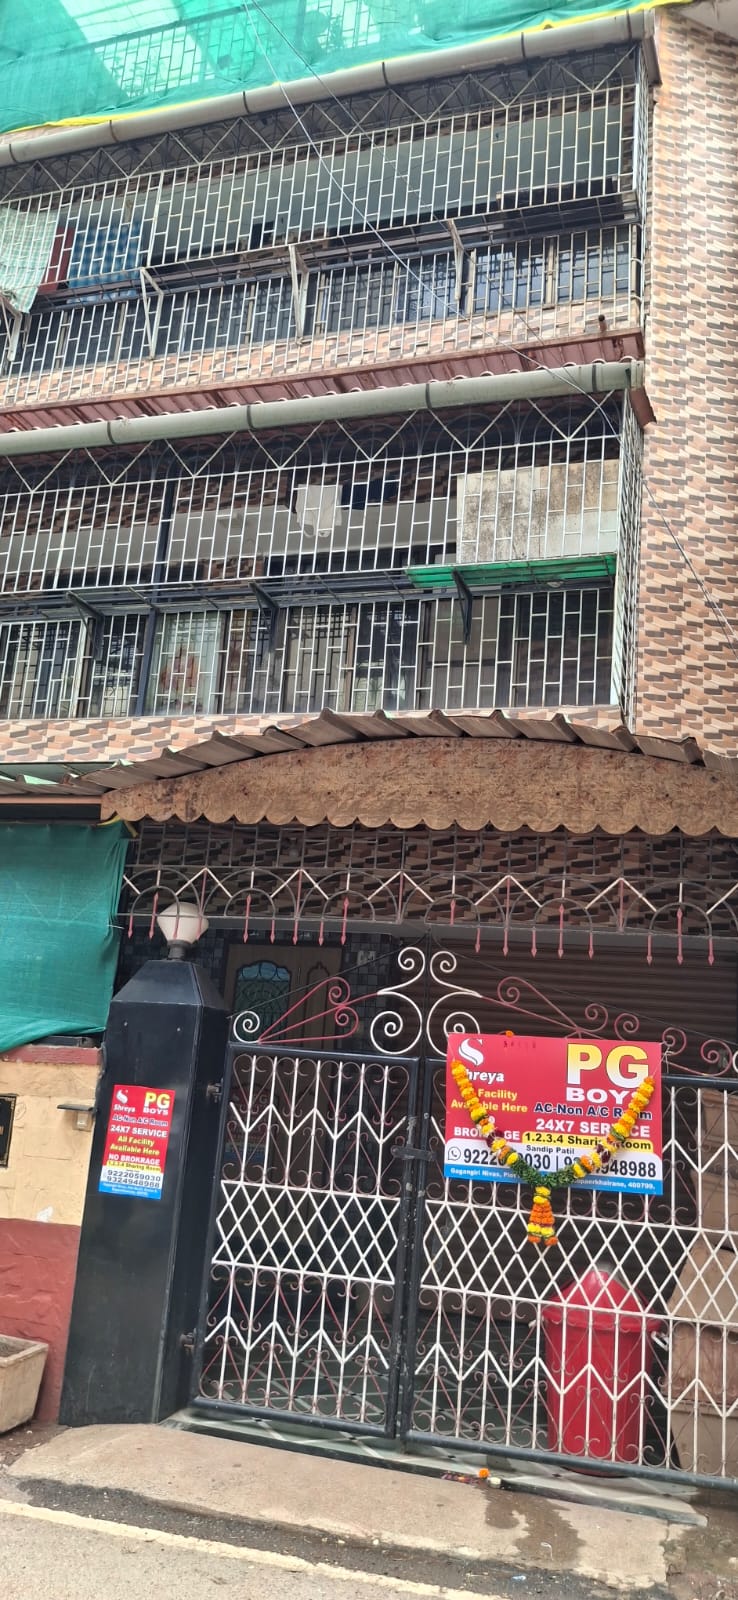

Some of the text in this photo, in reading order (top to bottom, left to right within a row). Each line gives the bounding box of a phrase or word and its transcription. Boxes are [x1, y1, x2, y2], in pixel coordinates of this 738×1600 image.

[567, 1043, 649, 1089] PG
[465, 1069, 505, 1085] hreya
[144, 1091, 171, 1109] PG
[477, 1088, 518, 1101] Facility
[113, 1104, 136, 1114] Shreya
[143, 1106, 169, 1116] BOYS
[451, 1098, 528, 1112] Avable Here
[534, 1102, 652, 1120] AC-Non A/C Rm
[110, 1124, 168, 1138] 24X7 SERVICE
[535, 1118, 651, 1138] 24X7 SERCE
[117, 1135, 155, 1147] All Facility
[525, 1132, 651, 1150] 1.2.3.4 Shari oom
[110, 1143, 161, 1156] Available Here
[525, 1144, 575, 1155] Sandip Patil
[108, 1153, 120, 1161] NO
